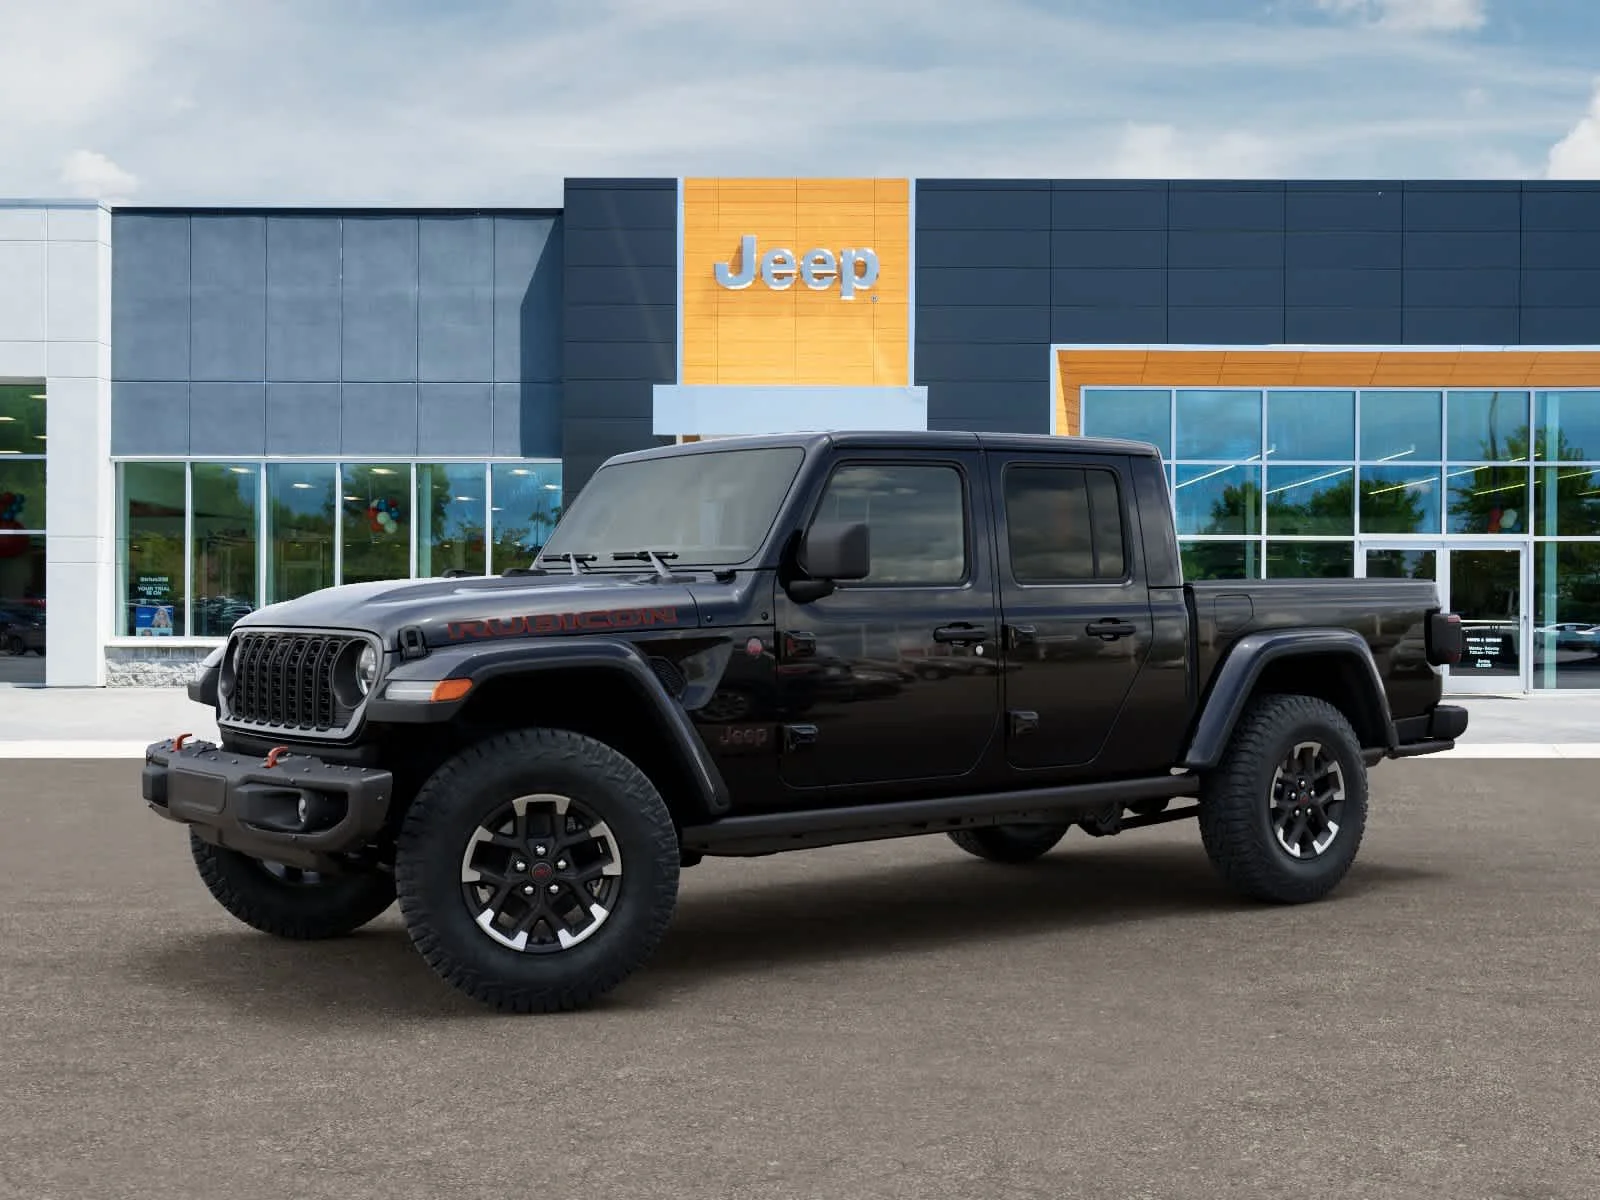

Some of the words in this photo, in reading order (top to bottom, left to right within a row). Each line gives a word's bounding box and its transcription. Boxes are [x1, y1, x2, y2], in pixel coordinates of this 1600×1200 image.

[714, 234, 880, 300] Jeep
[448, 606, 678, 640] RUBICON
[720, 726, 767, 746] Jeep
